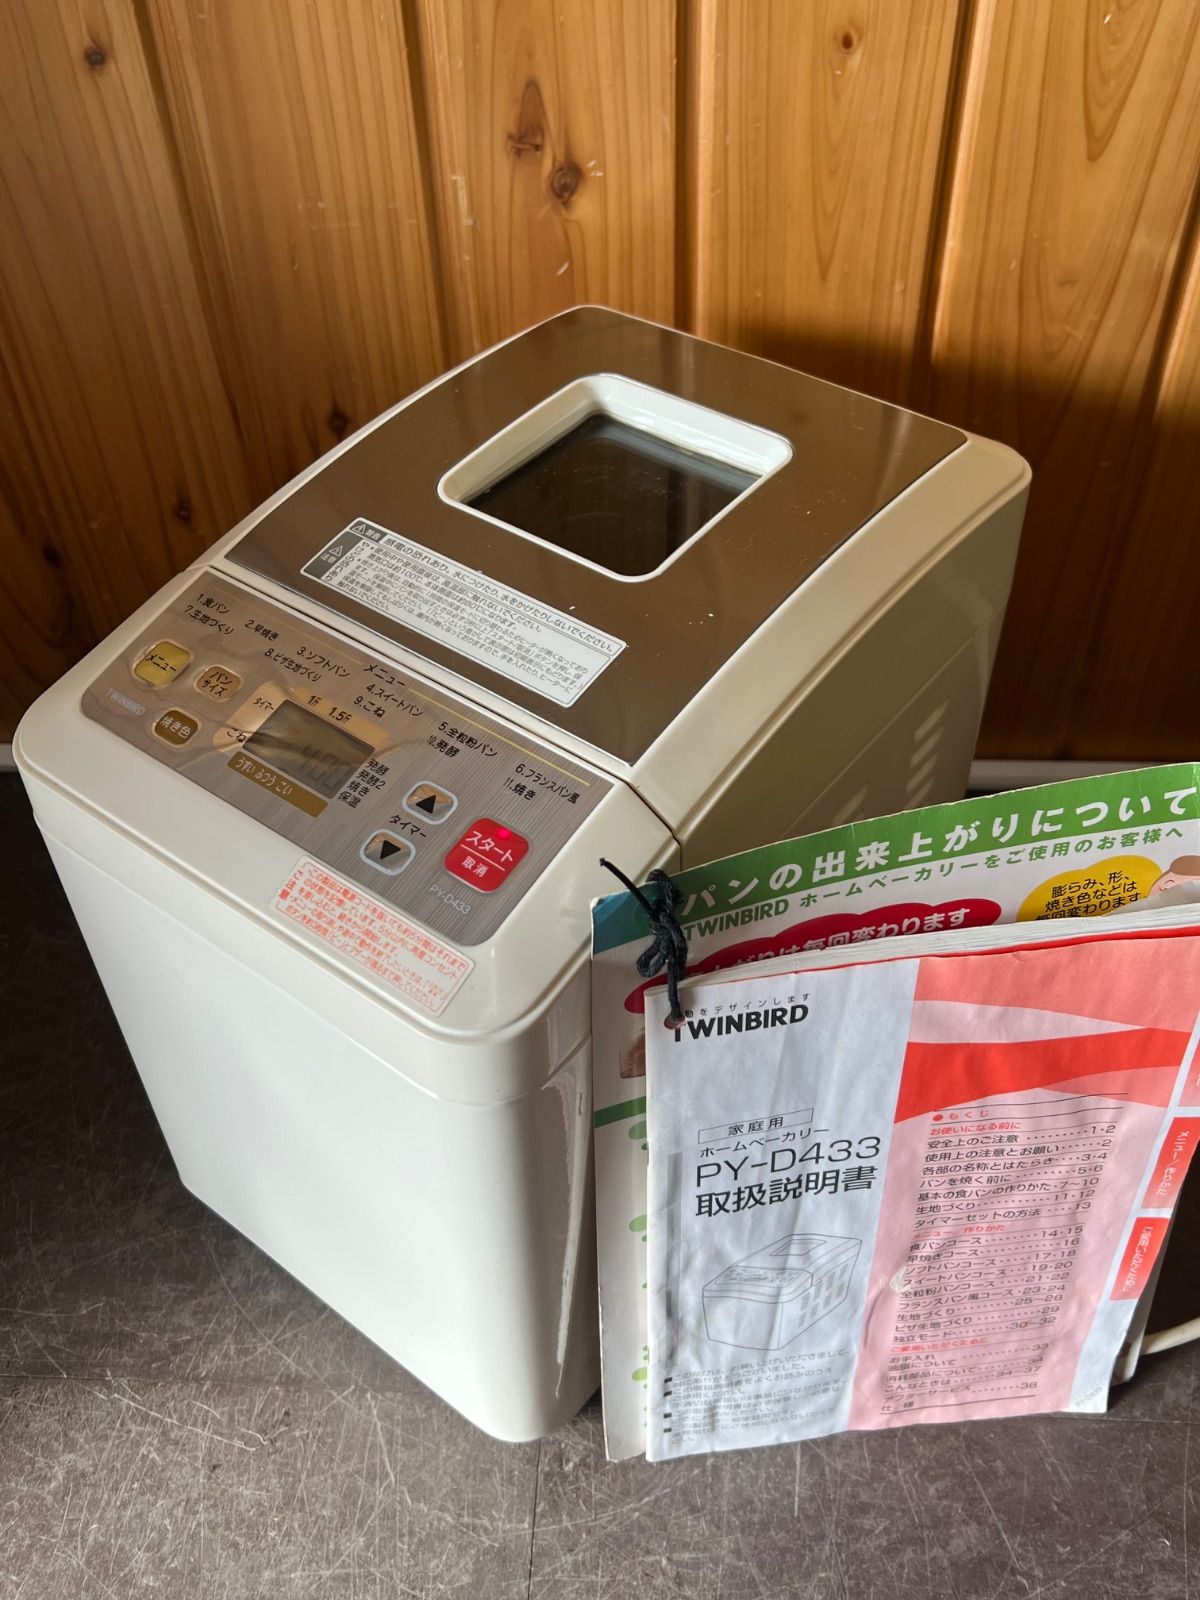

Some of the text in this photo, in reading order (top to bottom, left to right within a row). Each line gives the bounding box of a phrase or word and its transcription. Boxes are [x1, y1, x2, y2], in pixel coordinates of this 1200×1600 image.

[197, 593, 230, 615] 1.食パン
[184, 605, 234, 635] 7.生地づくり
[244, 619, 280, 641] 2.早焼き
[145, 654, 177, 672] メニュー
[297, 646, 351, 678] 3.ソフトパン
[209, 671, 233, 685] パン
[363, 664, 406, 687] メニュー
[201, 679, 227, 698] サイズ
[353, 696, 386, 718] 9.こね
[366, 683, 424, 717] 4.スイートパン
[159, 716, 192, 739] 焼き色
[438, 721, 498, 758] 5.全粒粉パン
[365, 758, 390, 777] 発酵
[346, 780, 371, 797] 焼き
[356, 769, 386, 790] 発酵2
[504, 776, 537, 801] 11.焼き
[515, 763, 580, 805] 6.フランスパン風
[338, 791, 361, 809] 保温
[388, 814, 427, 839] タイマー
[466, 830, 514, 863] スタート
[681, 787, 1197, 916] パンの出来上がりについて
[462, 856, 489, 877] 取消
[684, 827, 1184, 942] TWINBIRD ホームベーカリーをご使用のお客様へ
[1052, 871, 1130, 899] 膨らみ、形、
[429, 884, 472, 914] PY-D433
[1045, 882, 1137, 913] 焼き色などは
[949, 1110, 990, 1120] もくじ
[728, 1116, 784, 1136] 家庭用
[930, 1122, 1023, 1136] お使いになる前に
[700, 1128, 829, 1158] ホームベーカリー
[927, 1135, 1019, 1149] 安全上のご注意
[697, 1136, 881, 1188] PY-D433
[925, 1145, 1059, 1163] 使用上の注意とお願い
[922, 1157, 1056, 1176] 各部の名称とはたらき
[918, 1182, 1051, 1201] 基本の食パンの作りかた
[920, 1174, 1012, 1188] パンを焼く前に
[696, 1166, 878, 1218] 取扱説明書
[915, 1209, 1041, 1229] タイマーセットの方法
[916, 1202, 975, 1215] 生地づくり
[907, 1238, 1080, 1263] 早焼きコース 16
[910, 1236, 982, 1251] 食パンコース
[905, 1259, 997, 1275] ソフトパンコース
[904, 1269, 1007, 1287] スイートパンコース
[899, 1289, 1014, 1310] フランスパン風コース
[902, 1280, 995, 1298] 全粒粉パンコース
[895, 1317, 973, 1332] ピザ生地づくり
[897, 1308, 955, 1321] 生地づくり
